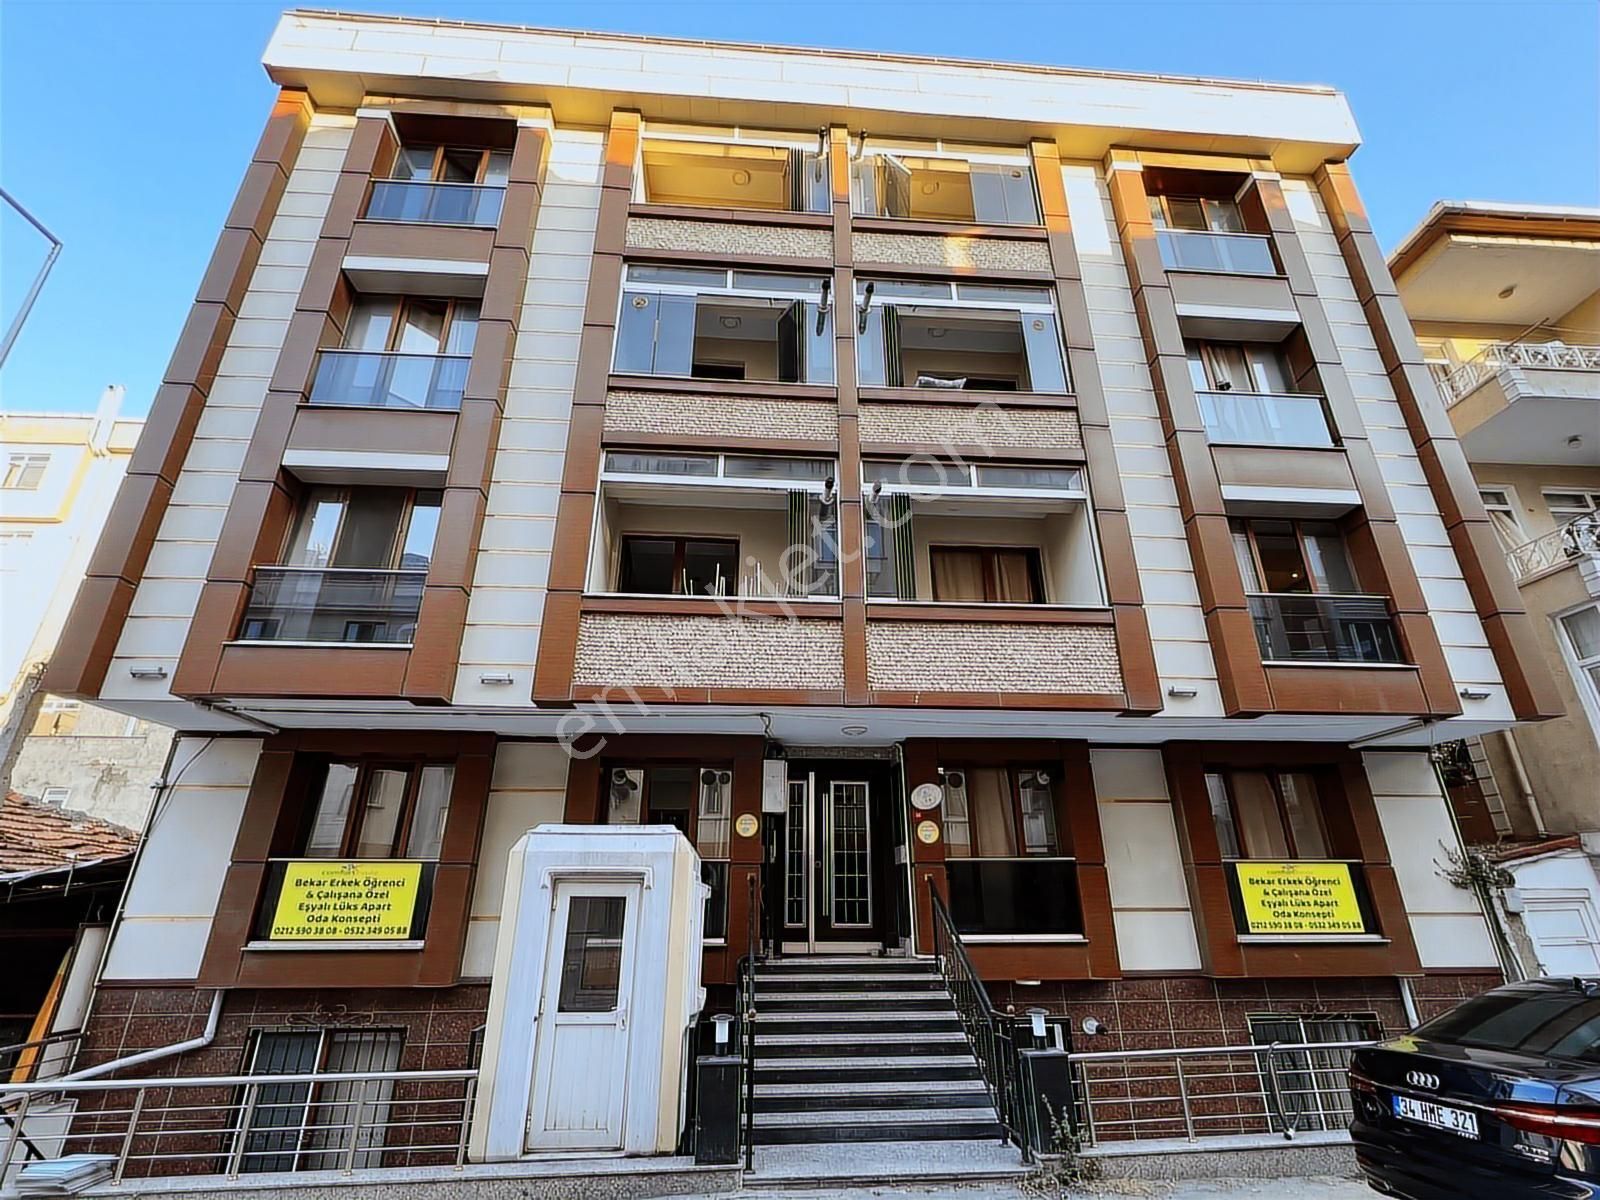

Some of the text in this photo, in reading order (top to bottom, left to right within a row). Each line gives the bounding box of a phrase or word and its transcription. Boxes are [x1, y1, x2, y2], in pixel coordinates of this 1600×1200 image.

[295, 876, 405, 888] Bekar Erkek Öğrenci
[1248, 876, 1341, 887] Bekar Erkek Öğrenci
[306, 888, 390, 900] & Çalışana Özel
[298, 902, 392, 912] Eşyalı Lüks Apart
[1313, 900, 1338, 908] Apart
[306, 914, 381, 924] Oda Konsepti
[1294, 910, 1335, 918] Konsepti
[274, 927, 294, 935] 0212
[326, 927, 337, 935] 08
[344, 927, 364, 935] 0532
[367, 927, 382, 935] 349
[384, 927, 394, 935] 05
[1401, 1098, 1416, 1116] 34
[1420, 1102, 1445, 1124] HME
[1450, 1110, 1476, 1132] 321
